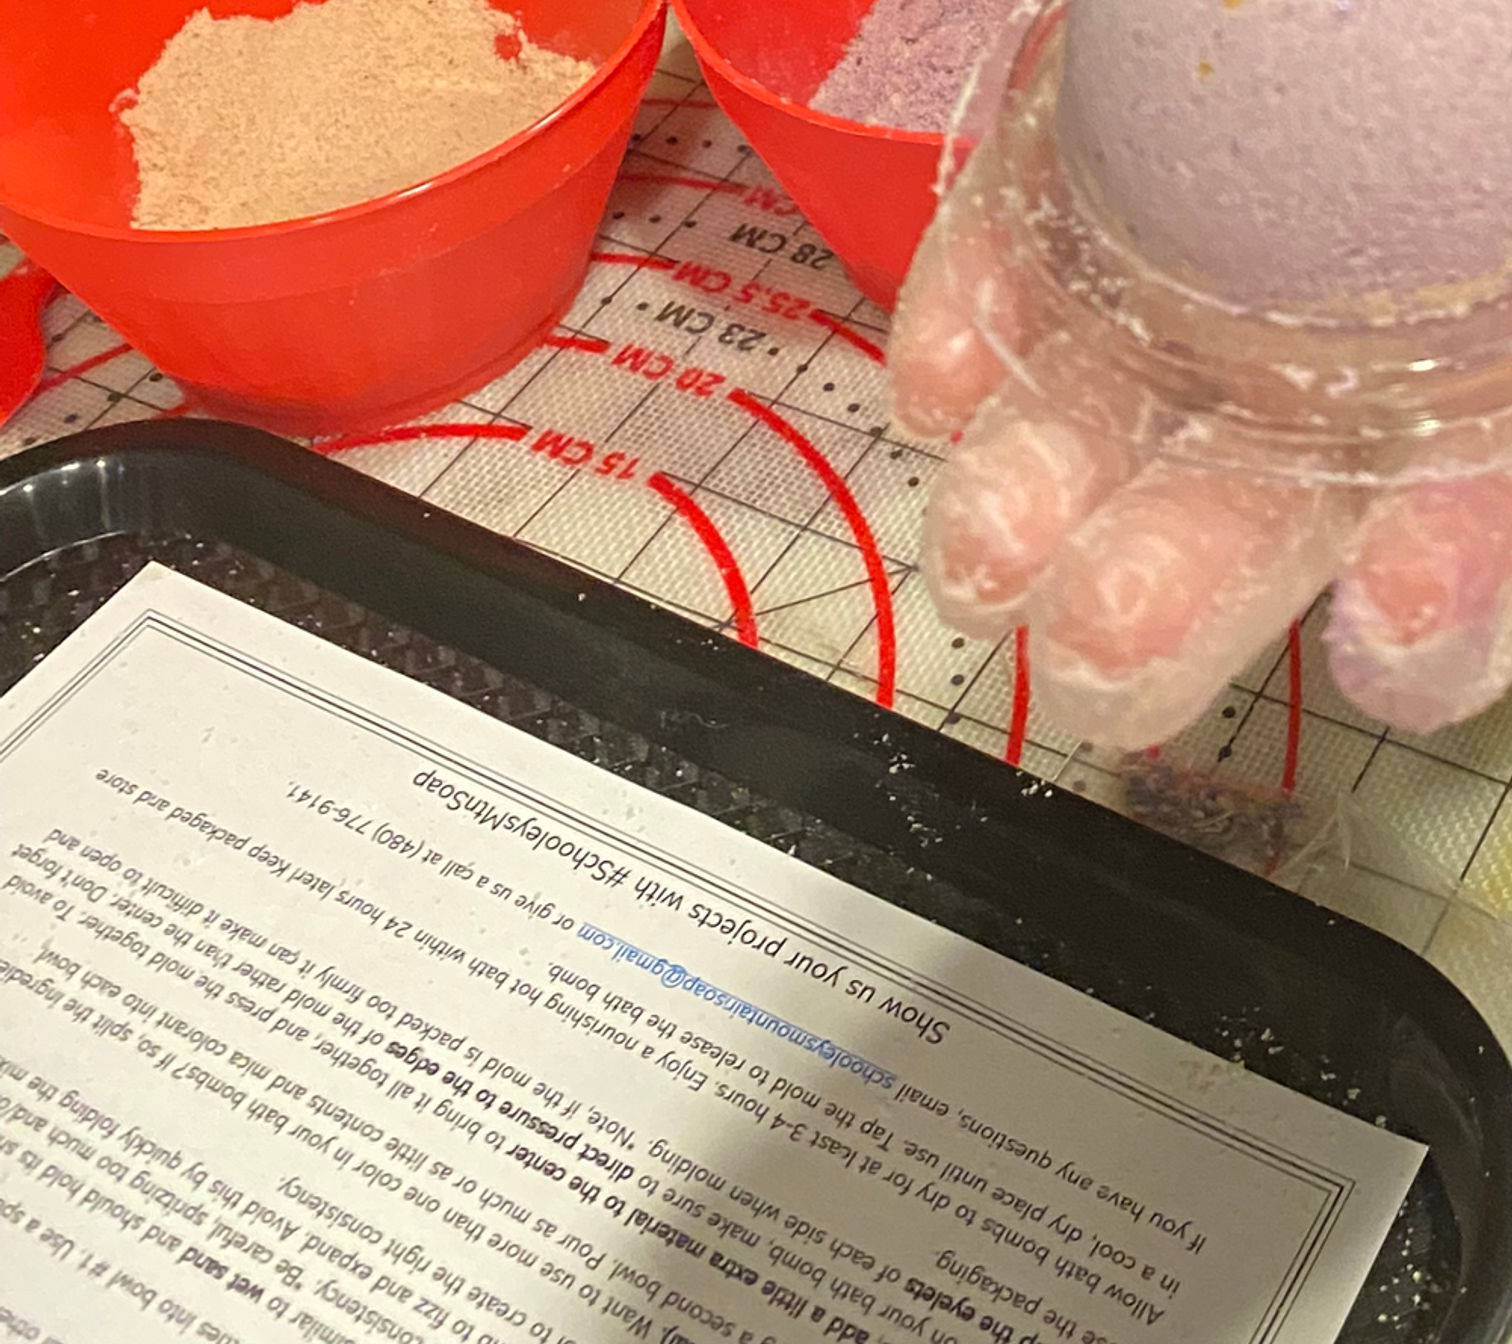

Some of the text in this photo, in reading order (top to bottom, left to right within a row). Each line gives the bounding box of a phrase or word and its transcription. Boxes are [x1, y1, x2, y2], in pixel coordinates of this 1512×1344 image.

[728, 223, 834, 271] 28 CM
[673, 260, 731, 292] CM
[655, 302, 766, 351] 23 CM
[611, 345, 725, 397] 20 CM
[530, 430, 640, 480] 15 CM
[95, 769, 139, 796] store
[132, 790, 171, 812] and
[42, 828, 81, 851] and
[164, 806, 252, 851] packaged
[371, 822, 426, 859] (480)
[79, 845, 123, 873] open
[247, 844, 292, 878] Keep
[421, 848, 444, 865] at
[439, 859, 475, 881] call
[122, 867, 144, 886] to
[475, 874, 490, 889] a
[489, 882, 513, 901] us
[140, 877, 205, 918] difficult
[334, 890, 386, 926] hours
[412, 769, 951, 1044] Show us your projects with #SchooleysMtnSoap
[513, 894, 557, 920] give
[202, 909, 221, 925] it
[382, 916, 414, 939] 24
[551, 914, 575, 931] or
[219, 918, 268, 949] make
[413, 929, 467, 964] within
[267, 943, 301, 966] can
[297, 959, 317, 975] it
[313, 965, 366, 1005] firmly
[467, 957, 511, 990] bath
[365, 994, 399, 1021] too
[508, 978, 544, 1007] hot
[393, 1011, 468, 1052] packed
[543, 992, 640, 1051] nourishing
[463, 1046, 484, 1063] is
[640, 1044, 656, 1060] a
[478, 1056, 533, 1088] mold
[654, 1050, 709, 1092] Enjoy
[532, 1081, 565, 1109] the
[559, 1099, 583, 1117] if
[714, 1081, 771, 1124] hours.
[893, 1083, 950, 1117] email
[548, 962, 1181, 1295] in a cool, dry place until use. Tap the mold to release the bath bomb.
[769, 1112, 808, 1142] 3-4
[957, 1108, 1053, 1170] questions,
[647, 1138, 727, 1192] molding.
[858, 1155, 883, 1176] at
[1054, 1161, 1095, 1191] any
[881, 1170, 915, 1197] for
[914, 1181, 952, 1213] dry
[728, 1185, 781, 1222] when
[954, 1204, 978, 1227] to
[1095, 1185, 1146, 1224] have
[783, 1214, 828, 1245] side
[980, 1217, 1051, 1267] bombs
[1148, 1211, 1193, 1241] you
[504, 1143, 871, 1344] add a little extra material to the center
[828, 1237, 876, 1271] each
[1186, 1233, 1208, 1256] If
[873, 1264, 902, 1284] of
[1054, 1255, 1102, 1294] bath
[902, 1276, 977, 1323] eyelets
[1102, 1283, 1166, 1325] Allow
[978, 1314, 1015, 1344] the
[1042, 1308, 1078, 1341] the
